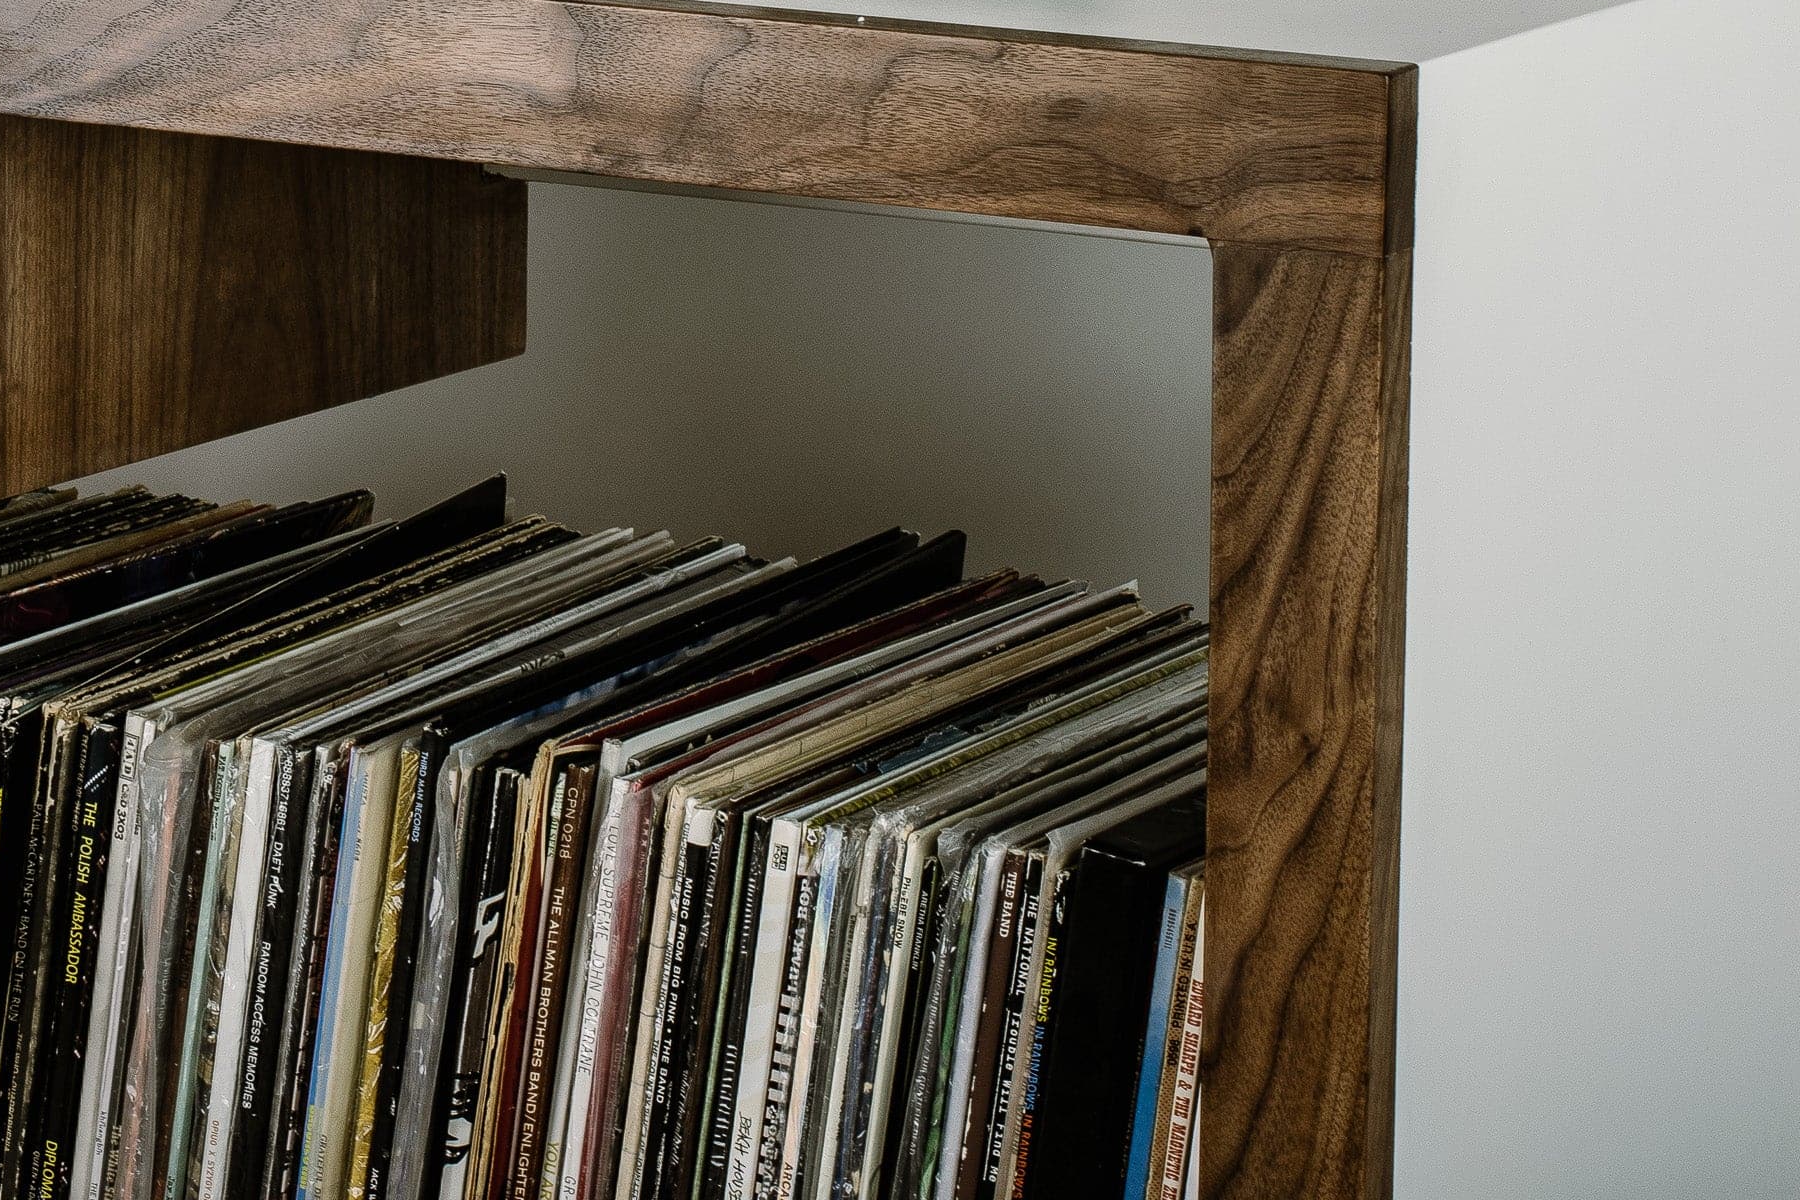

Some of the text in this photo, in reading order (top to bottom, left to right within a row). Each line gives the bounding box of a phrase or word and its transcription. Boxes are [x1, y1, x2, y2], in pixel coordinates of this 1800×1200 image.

[410, 751, 429, 843] THIRD MAN RECORDS
[558, 786, 578, 859] CPN 0218
[605, 825, 621, 862] LOVE
[7, 802, 42, 1022] PAUL McCARTNEY BAND ON THE RUN
[63, 801, 97, 984] THE POLISH AMBASSADOR
[266, 875, 280, 908] PUNK
[594, 867, 616, 941] SUPREME
[679, 877, 693, 919] MUSIC
[997, 871, 1017, 938] THE BAND
[673, 924, 687, 961] FROM
[910, 889, 929, 970] ARETHA FRANKLIN
[255, 941, 271, 993] RANDOM
[588, 950, 606, 992] JOHN
[670, 965, 681, 988] BIG
[248, 995, 265, 1043] ACCESS
[665, 992, 678, 1023] PINK
[576, 996, 599, 1076] COLTRANE
[660, 1038, 672, 1063] THE
[987, 893, 1038, 1182] THE NATIONAL Trouble Will Find Me
[240, 1045, 259, 1109] MEMORIES
[654, 1066, 668, 1104] BAND
[1166, 979, 1204, 1182] EDWARD SHARPE & THE MAGNETIC
[733, 1111, 754, 1156] BEACH
[368, 1168, 379, 1190] JACK
